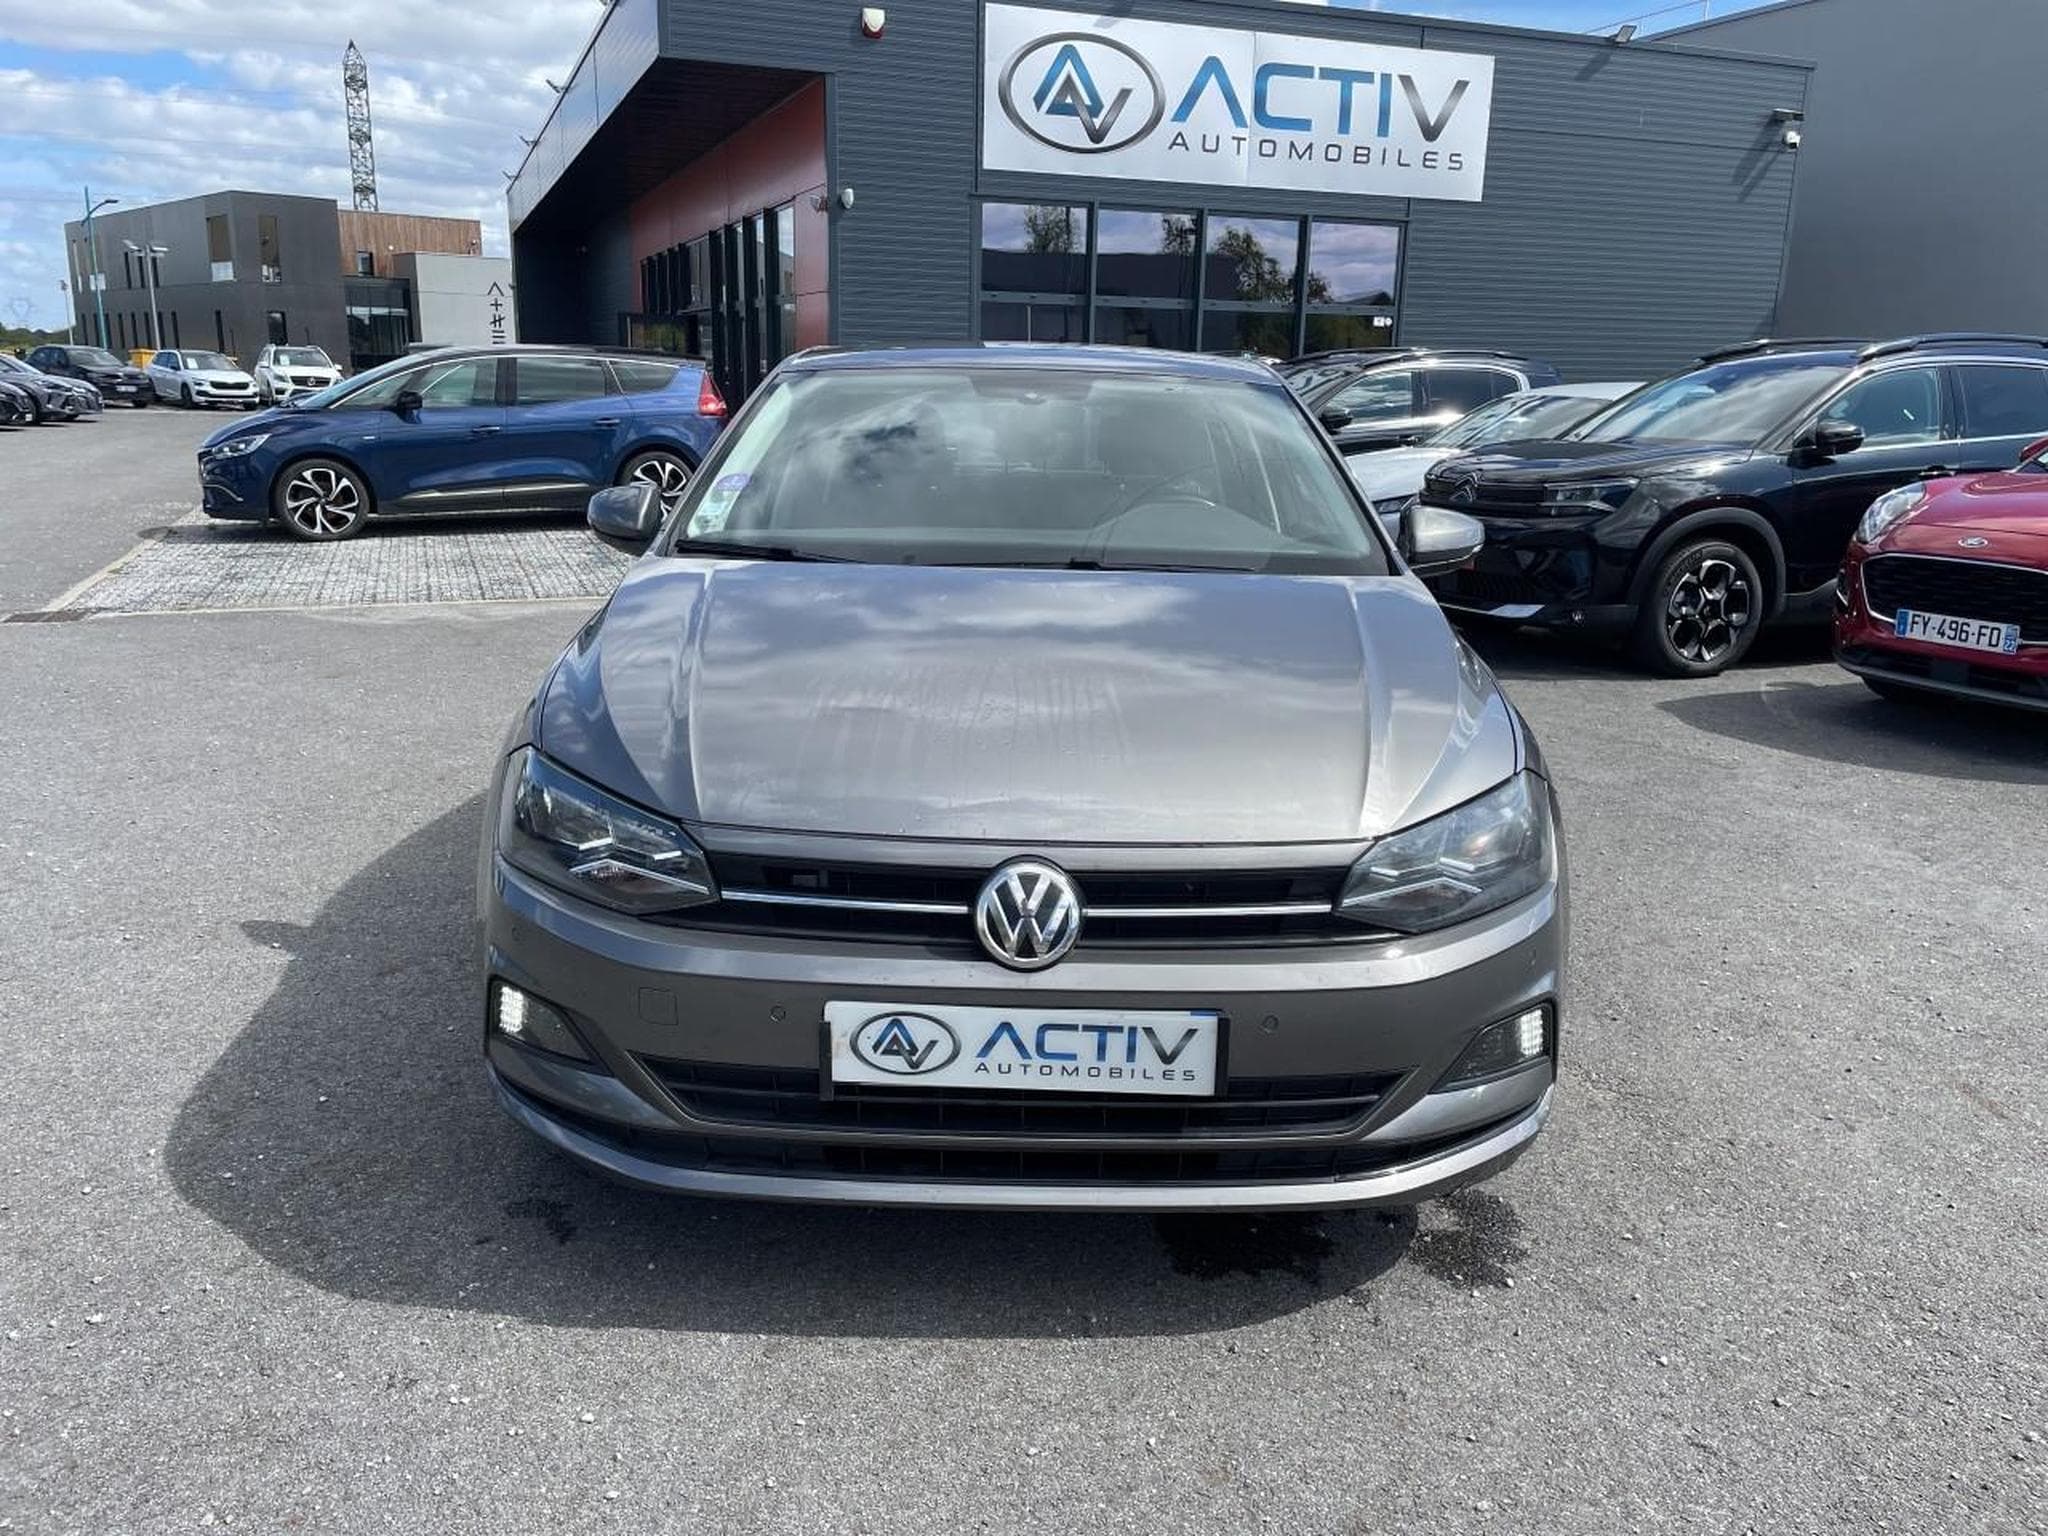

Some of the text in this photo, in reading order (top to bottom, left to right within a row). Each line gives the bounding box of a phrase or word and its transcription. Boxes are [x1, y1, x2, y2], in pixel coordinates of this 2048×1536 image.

[1170, 55, 1470, 143] ACTIV
[1168, 133, 1464, 171] AUTOMOBILES
[1910, 613, 2001, 648] FY-496-FD
[975, 1021, 1199, 1066] ACTIV
[974, 1062, 1197, 1082] AUTOMOBILES
